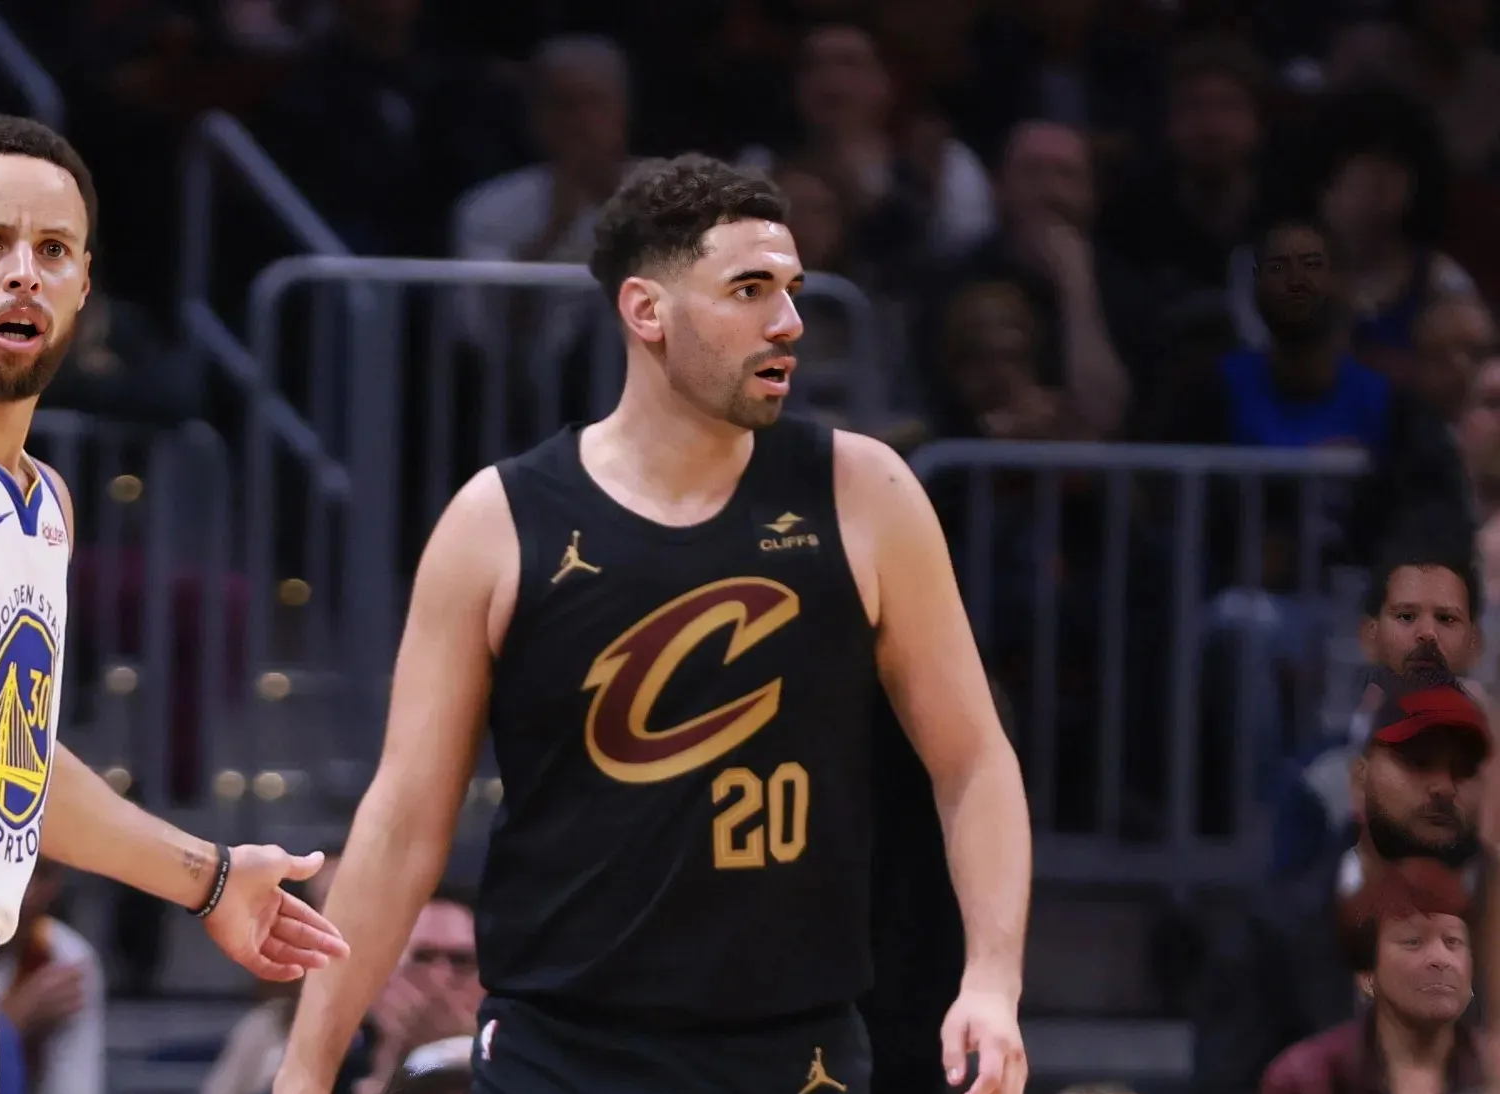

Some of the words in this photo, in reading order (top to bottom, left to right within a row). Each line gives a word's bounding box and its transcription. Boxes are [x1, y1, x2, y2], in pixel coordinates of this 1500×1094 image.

[759, 533, 820, 551] CLIFFS
[27, 668, 53, 731] 30
[711, 761, 810, 869] 20
